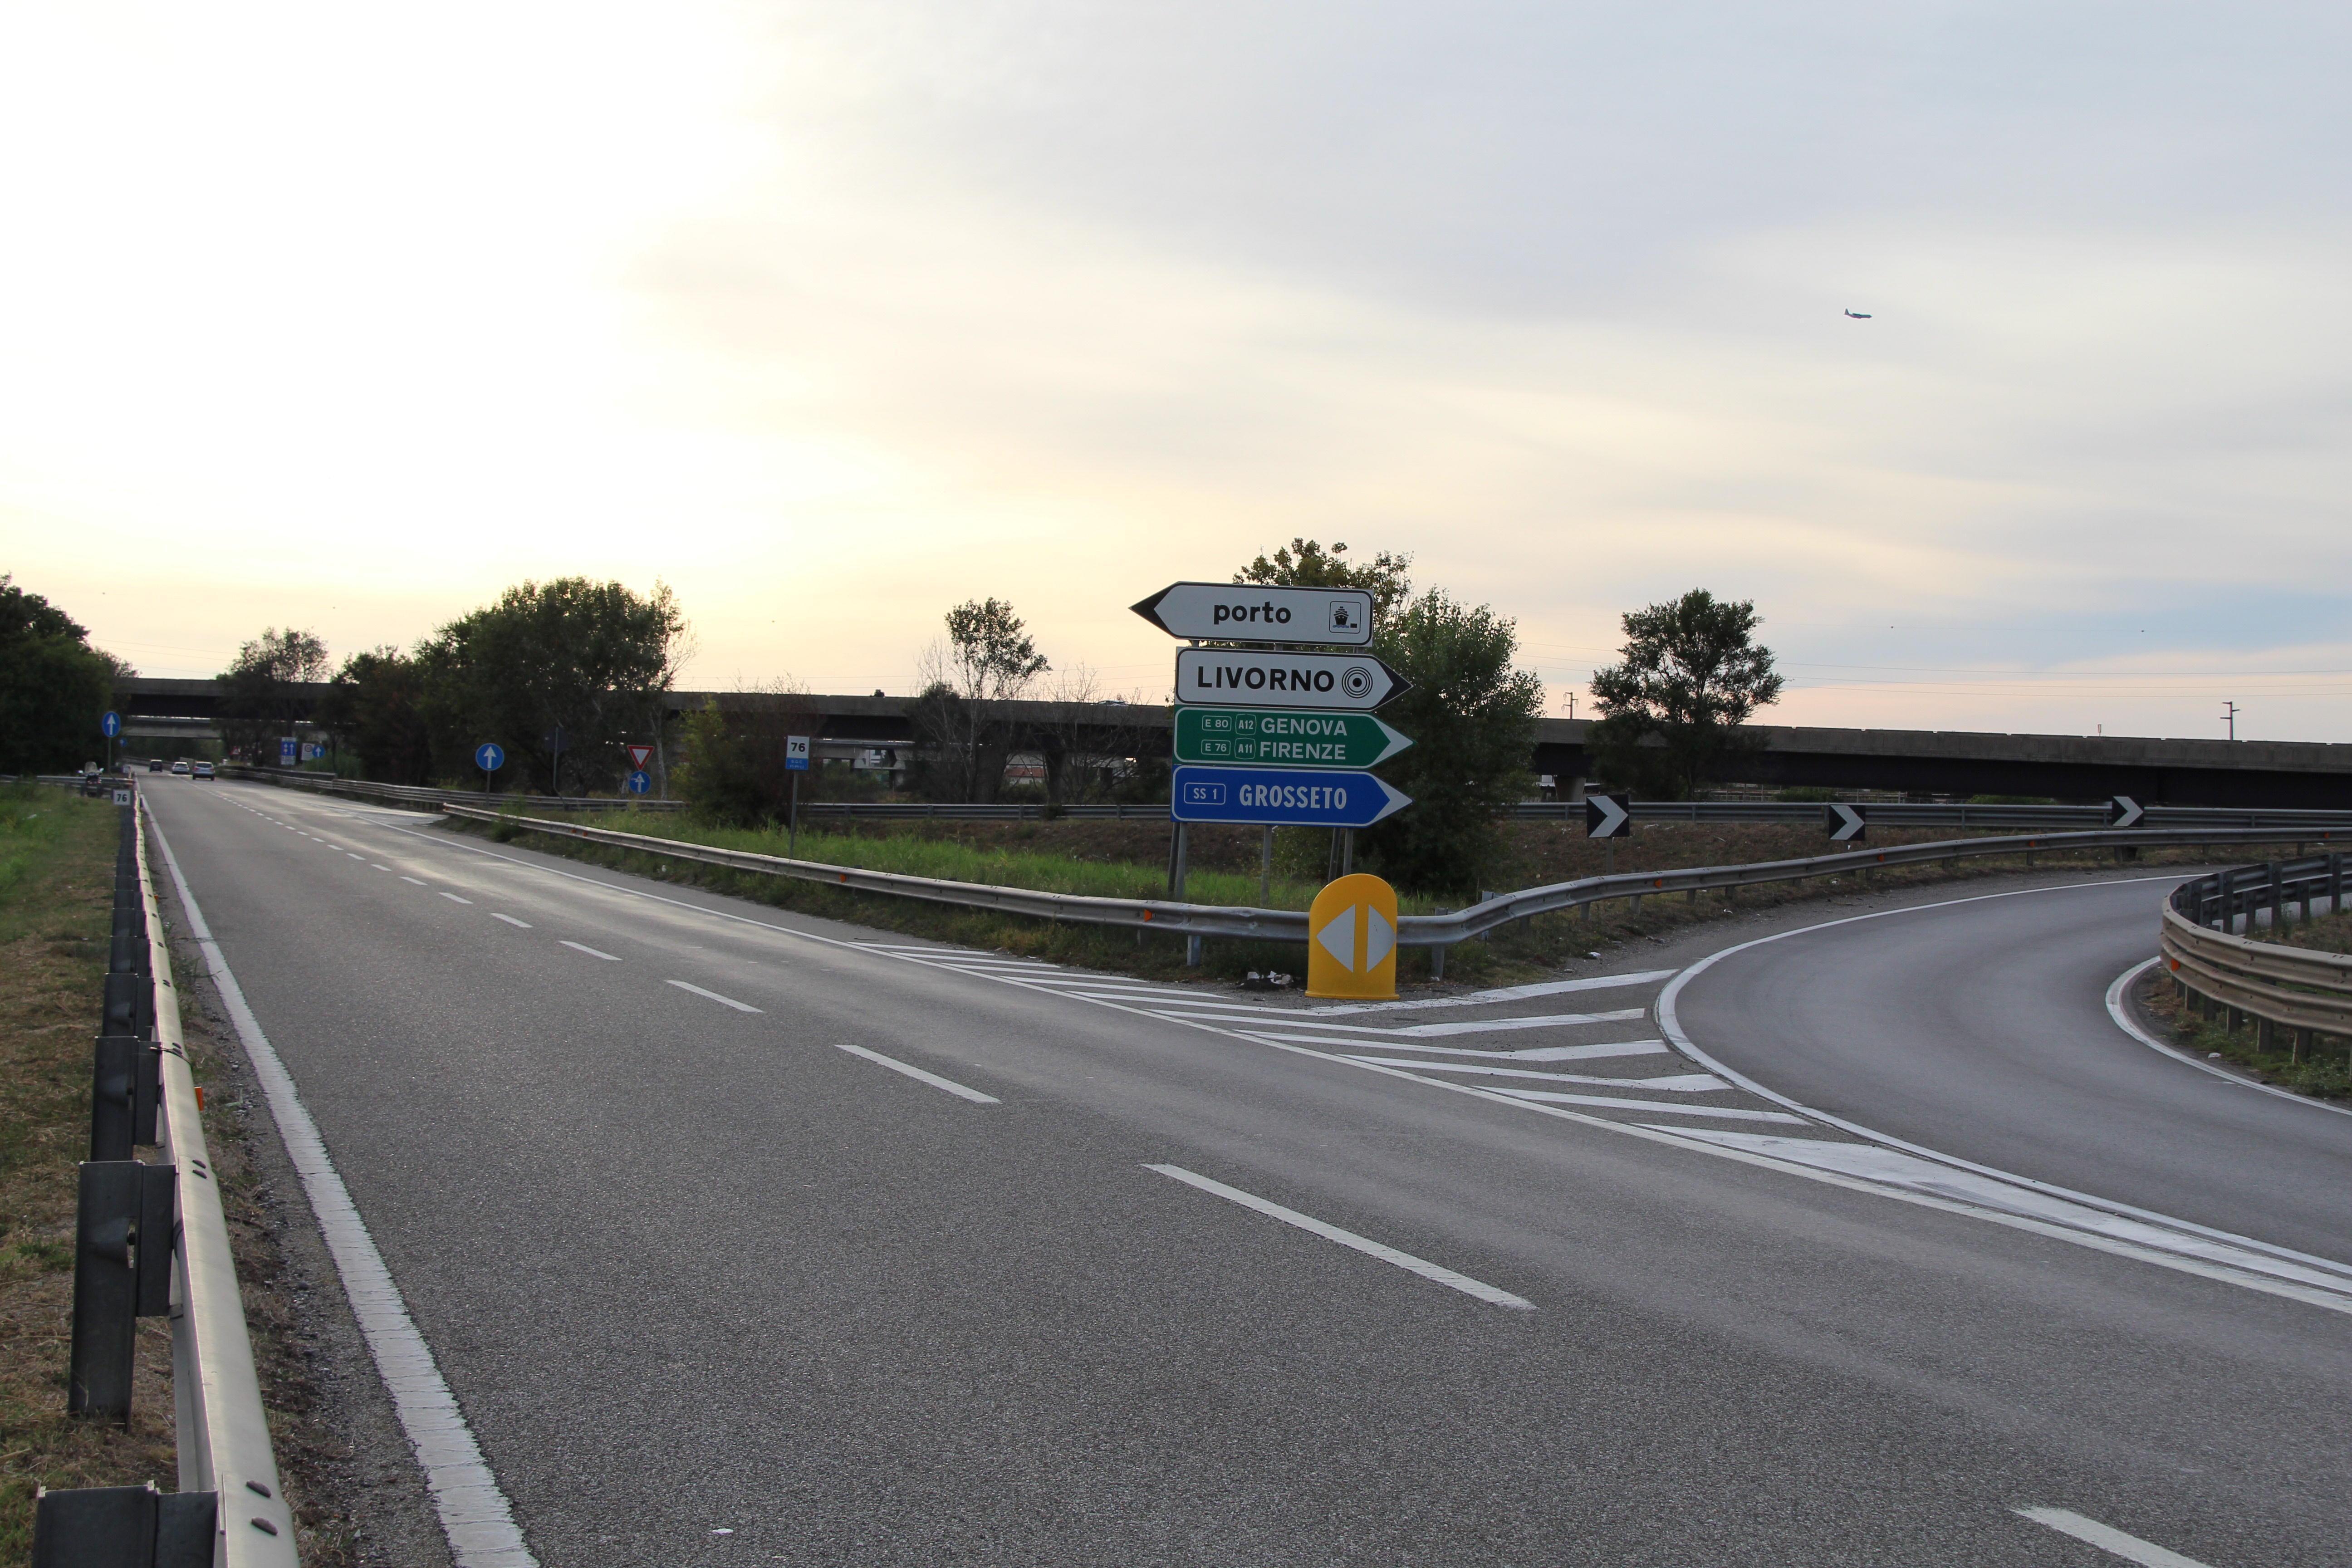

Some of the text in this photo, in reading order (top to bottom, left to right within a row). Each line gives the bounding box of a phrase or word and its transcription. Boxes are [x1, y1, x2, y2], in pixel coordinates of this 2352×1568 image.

[1214, 601, 1291, 625] porto
[1198, 666, 1334, 692] LIVORNO
[1205, 719, 1229, 728] E 80
[1238, 720, 1254, 730] A12
[1261, 718, 1348, 736] GENOVA
[791, 742, 805, 752] 76
[1205, 743, 1227, 752] E 76
[1238, 744, 1252, 753] A11
[1260, 741, 1346, 760] FIRENZE
[117, 794, 127, 802] 76
[1193, 788, 1217, 799] SS 1
[1239, 784, 1347, 809] GROSSETO
